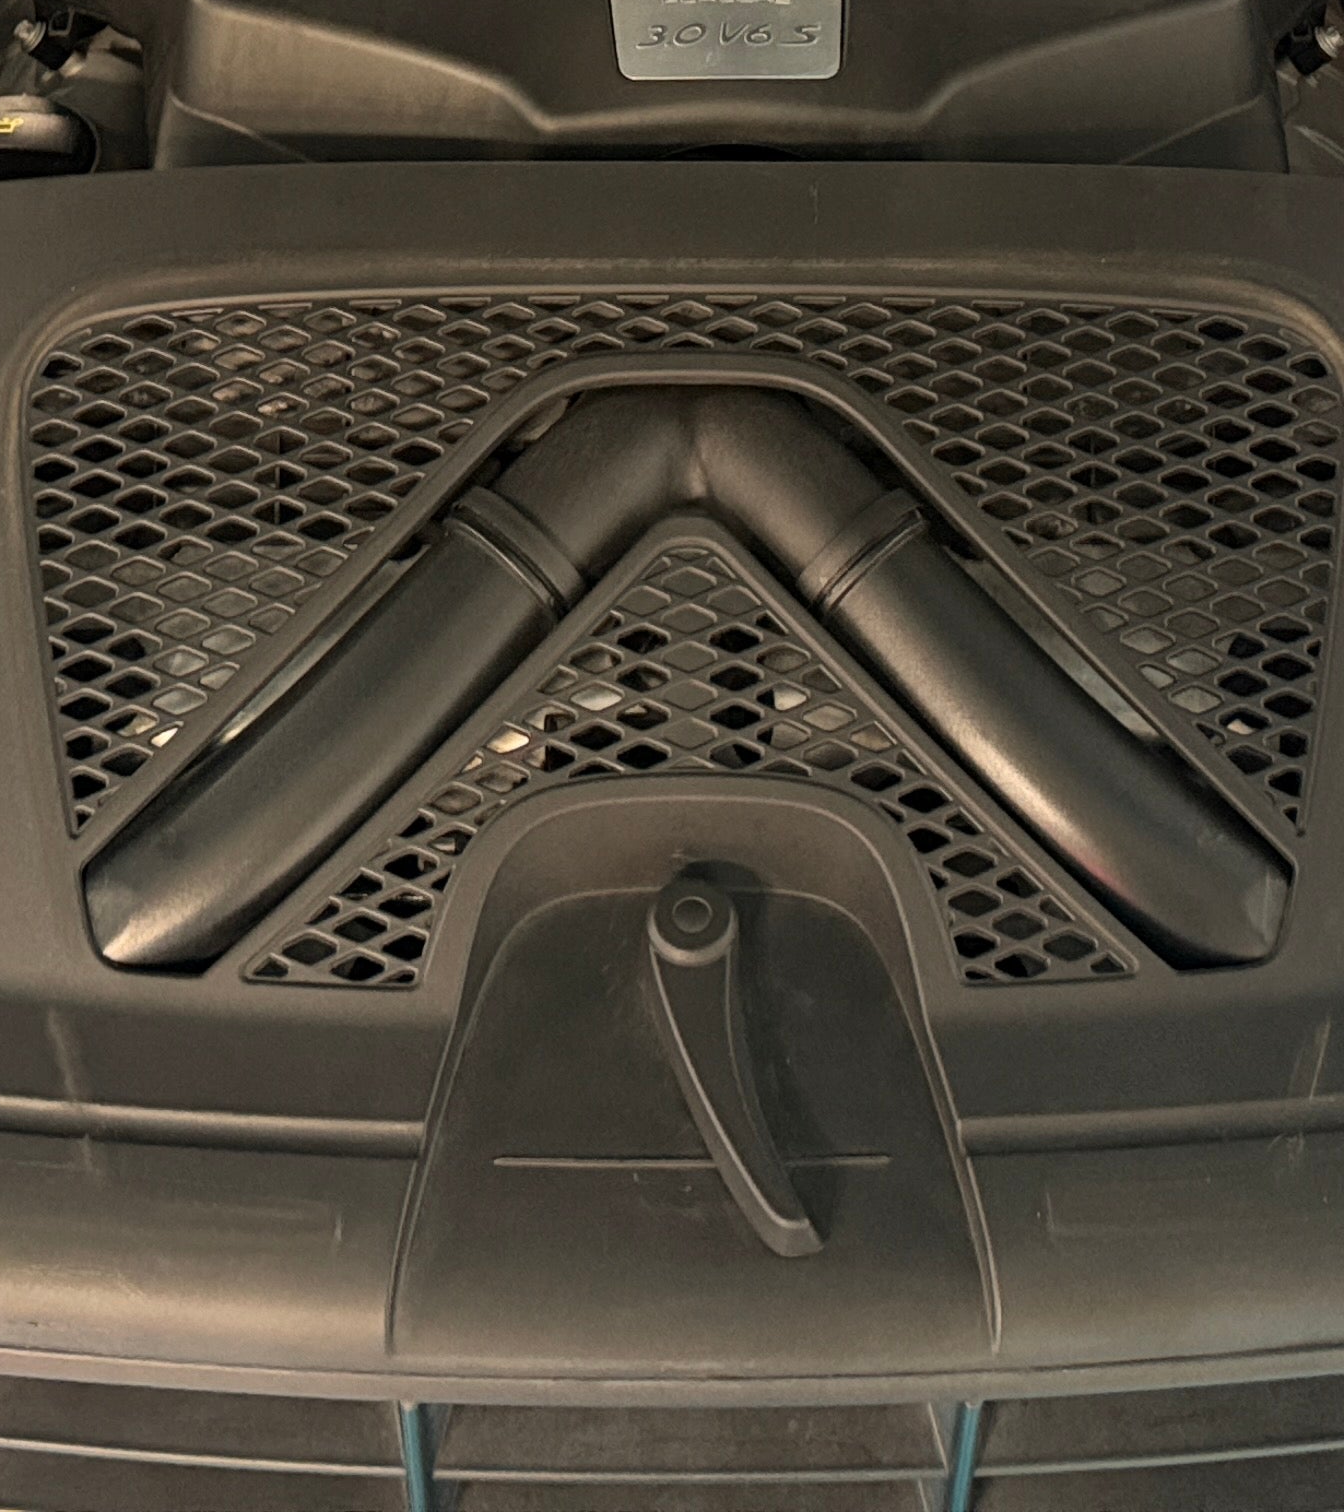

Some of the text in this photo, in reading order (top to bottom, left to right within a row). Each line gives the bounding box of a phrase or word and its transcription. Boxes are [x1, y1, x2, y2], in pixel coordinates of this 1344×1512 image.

[636, 21, 821, 49] 3.0 V6 S
